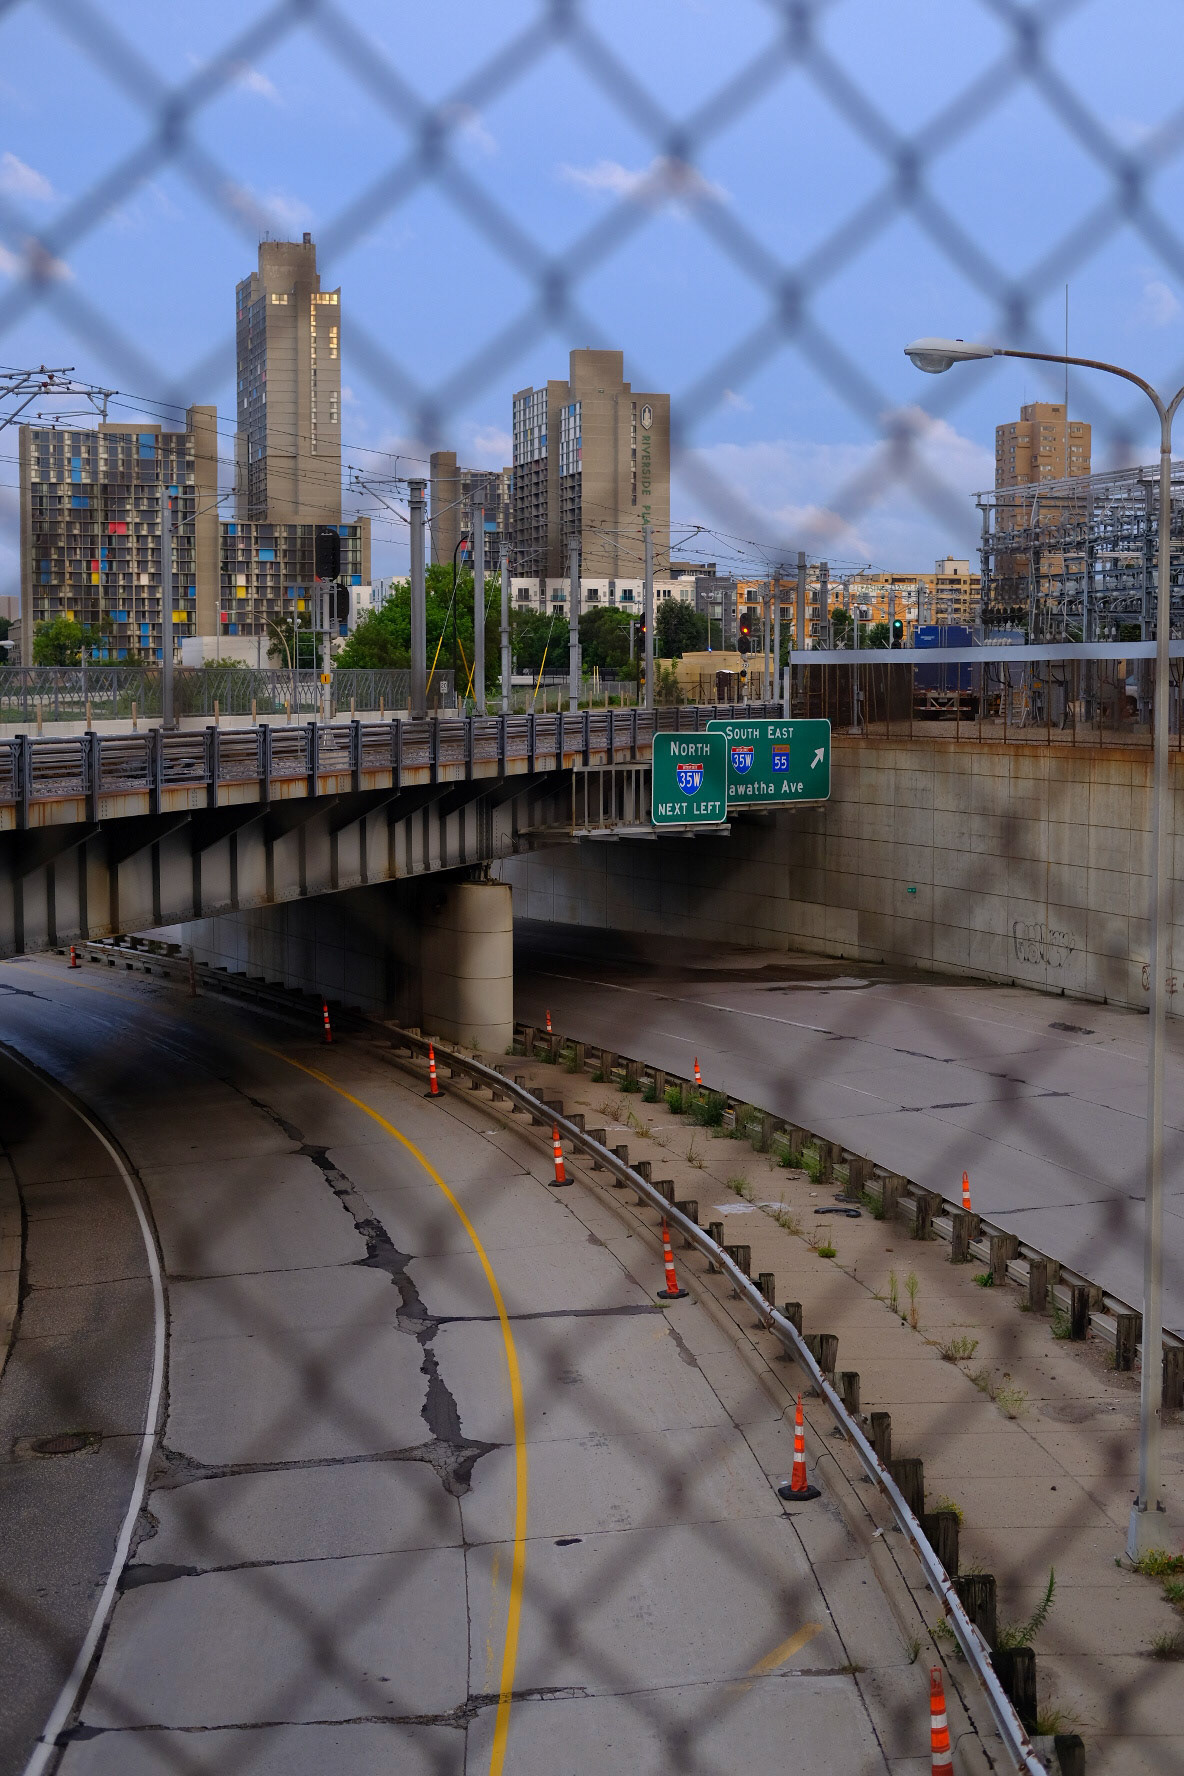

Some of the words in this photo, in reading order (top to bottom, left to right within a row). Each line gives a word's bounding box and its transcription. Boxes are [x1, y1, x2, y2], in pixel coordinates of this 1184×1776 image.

[641, 435, 651, 495] RIVERSIDE
[725, 727, 760, 740] SOUTH
[767, 725, 794, 739] EAST
[670, 741, 710, 756] NORTH
[733, 754, 752, 768] 35W
[774, 756, 788, 769] 55
[680, 772, 701, 788] 35W
[729, 782, 774, 795] awatha
[781, 779, 804, 794] Ave
[658, 803, 688, 816] NEXT
[693, 801, 721, 815] LEFT
